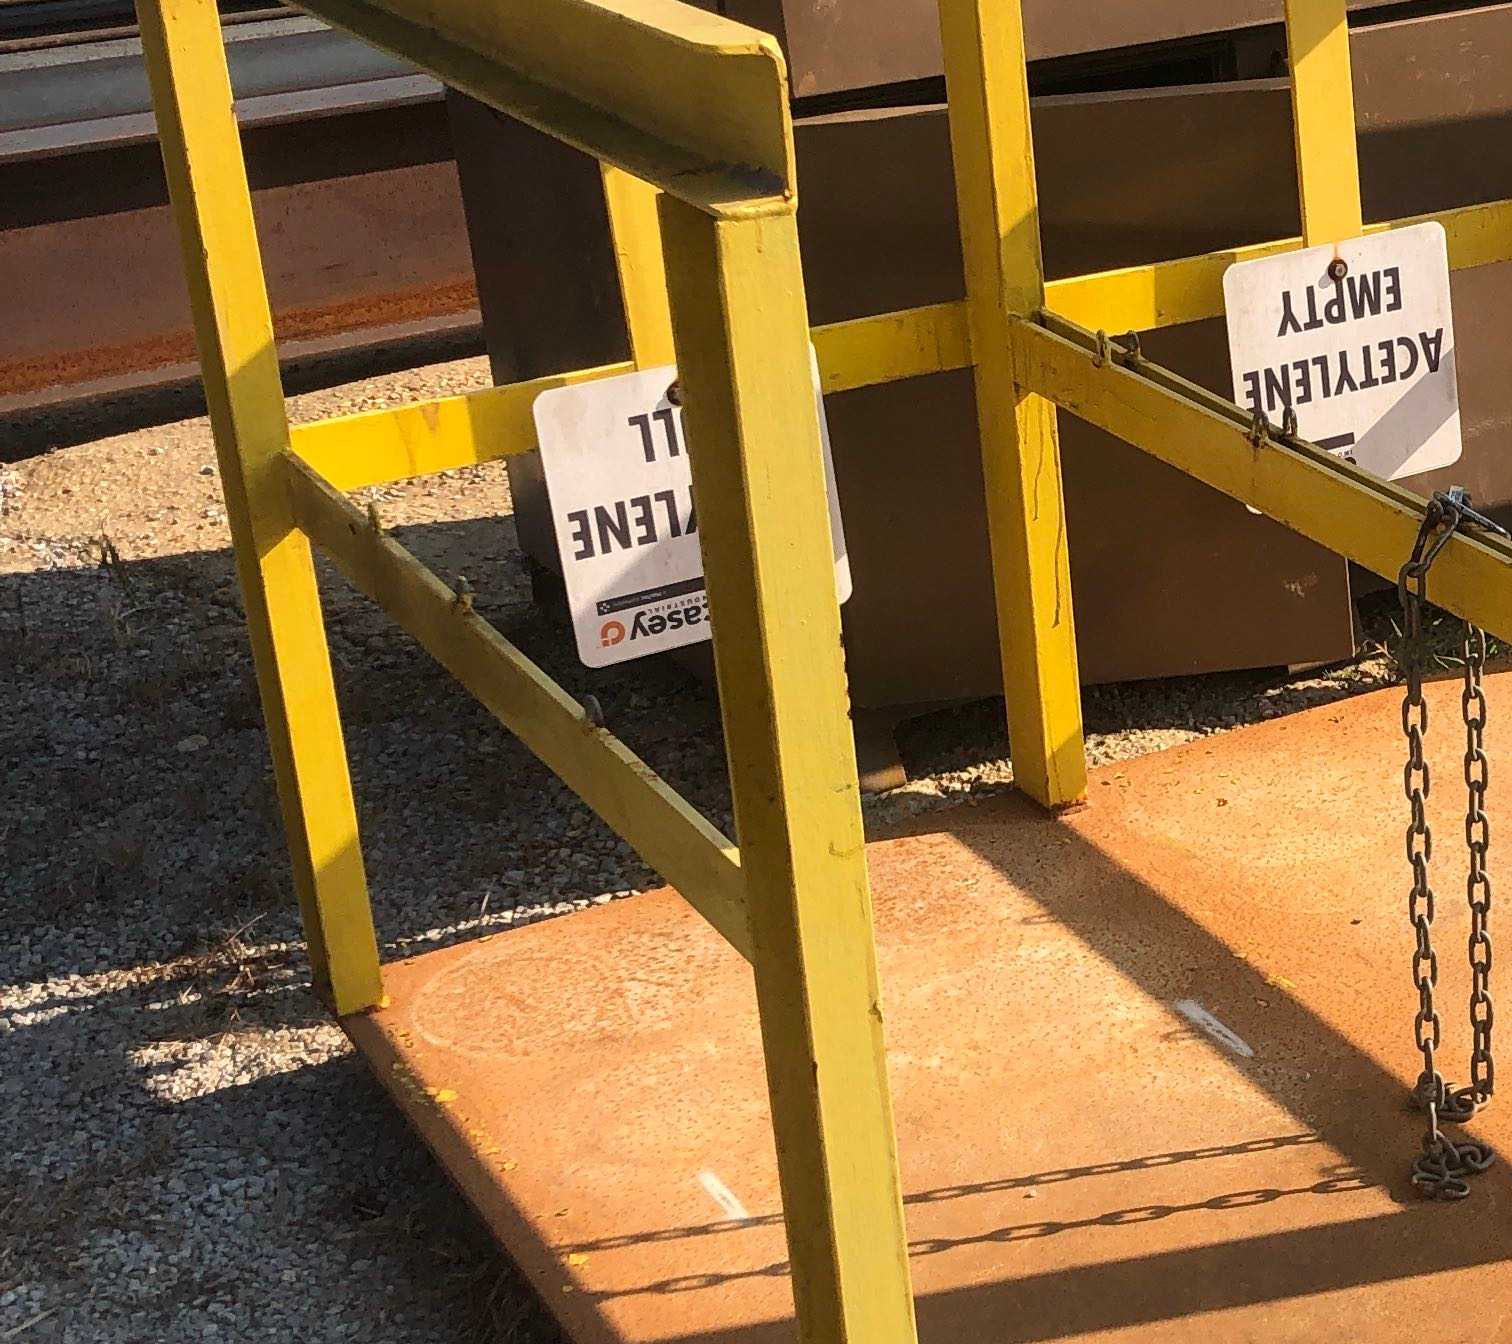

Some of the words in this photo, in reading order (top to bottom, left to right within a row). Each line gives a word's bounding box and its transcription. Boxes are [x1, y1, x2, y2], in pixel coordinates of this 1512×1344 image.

[1277, 266, 1402, 337] EMPTY
[1243, 327, 1443, 412] ACETYLENE
[628, 408, 680, 462] LL
